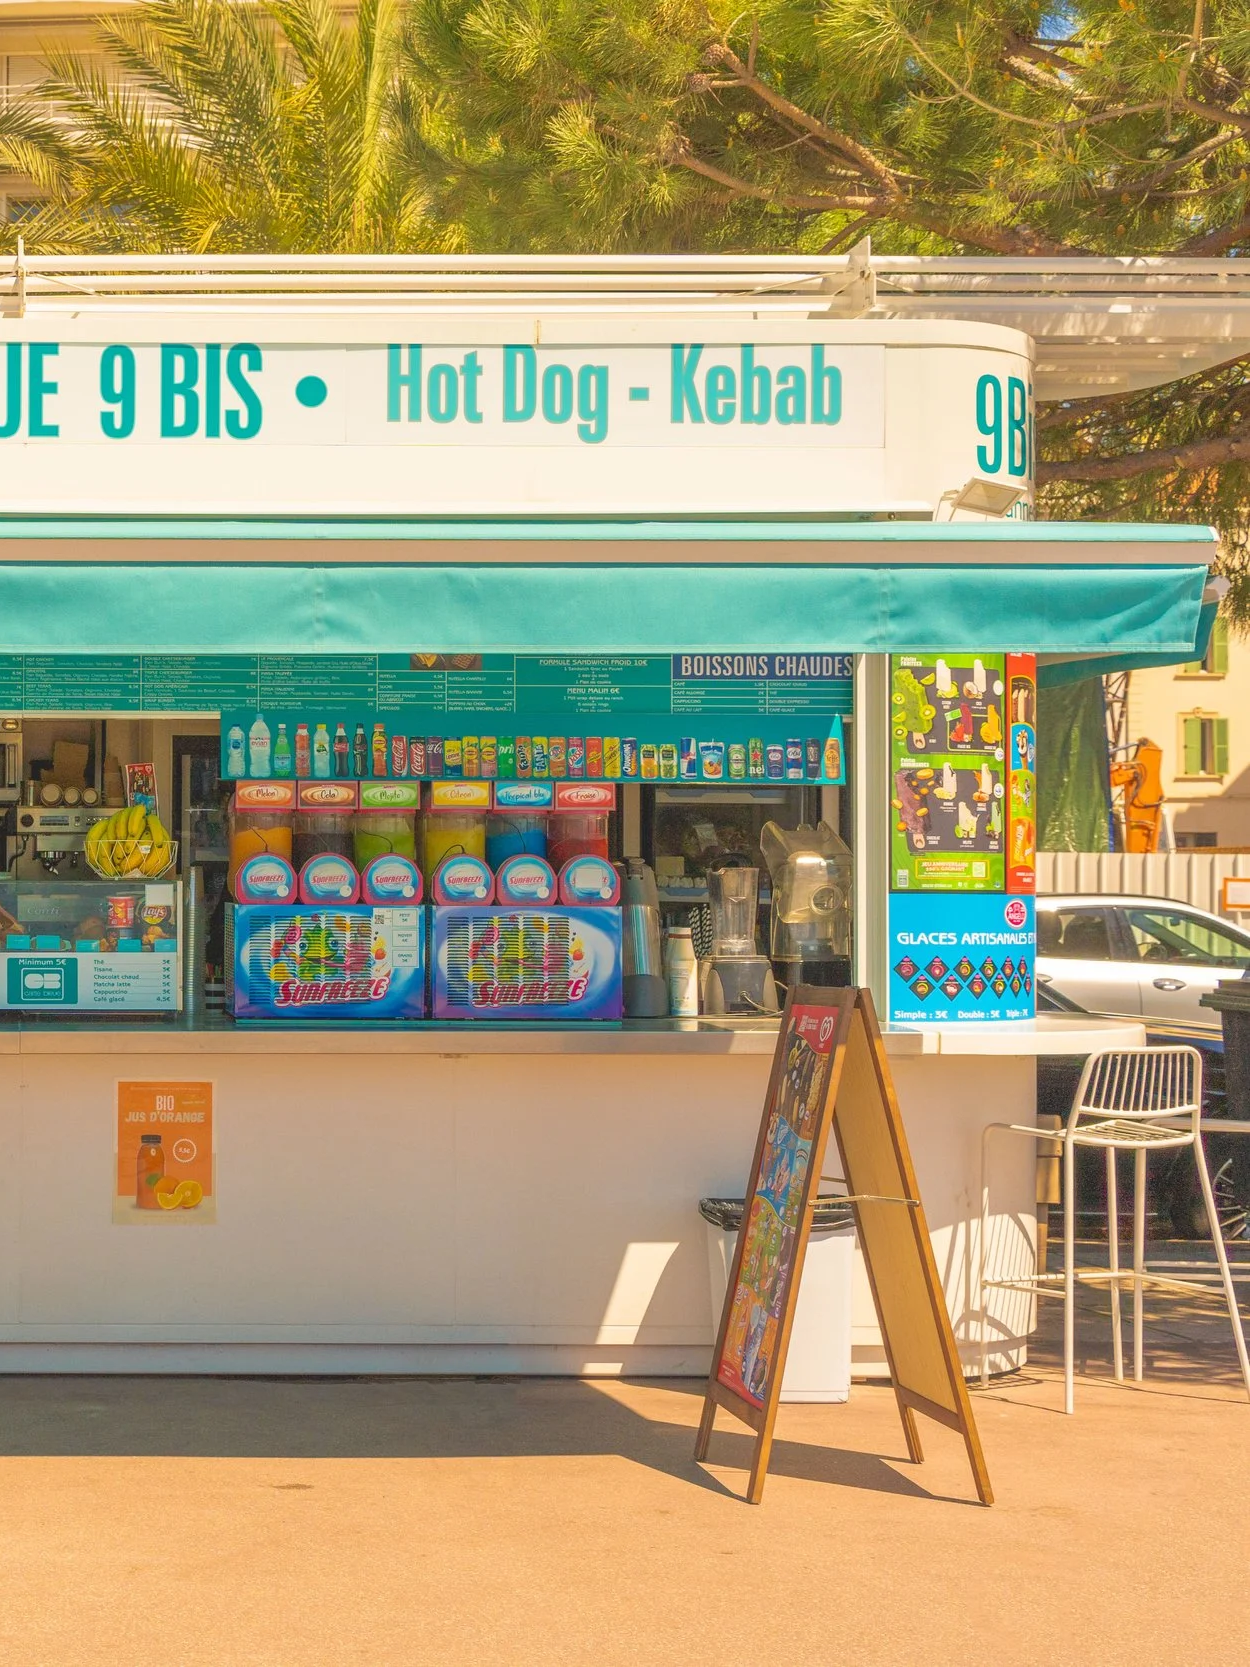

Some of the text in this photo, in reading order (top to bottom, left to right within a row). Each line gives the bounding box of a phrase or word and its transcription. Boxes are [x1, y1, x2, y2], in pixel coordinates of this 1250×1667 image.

[100, 344, 136, 439] 9
[160, 343, 263, 440] BIS
[386, 344, 483, 423] Hot
[502, 344, 609, 443] Dog
[670, 344, 843, 425] Kebab
[681, 655, 853, 677] BOISSONS CHAUDES
[896, 932, 958, 945] GLACES
[960, 932, 1027, 945] ARTISANALES
[18, 958, 54, 966] Minimum
[276, 975, 391, 1006] SUNFREEZE
[894, 1010, 926, 1020] Simple
[958, 1010, 985, 1019] Double
[156, 1095, 175, 1111] BIO
[125, 1112, 146, 1122] JUS
